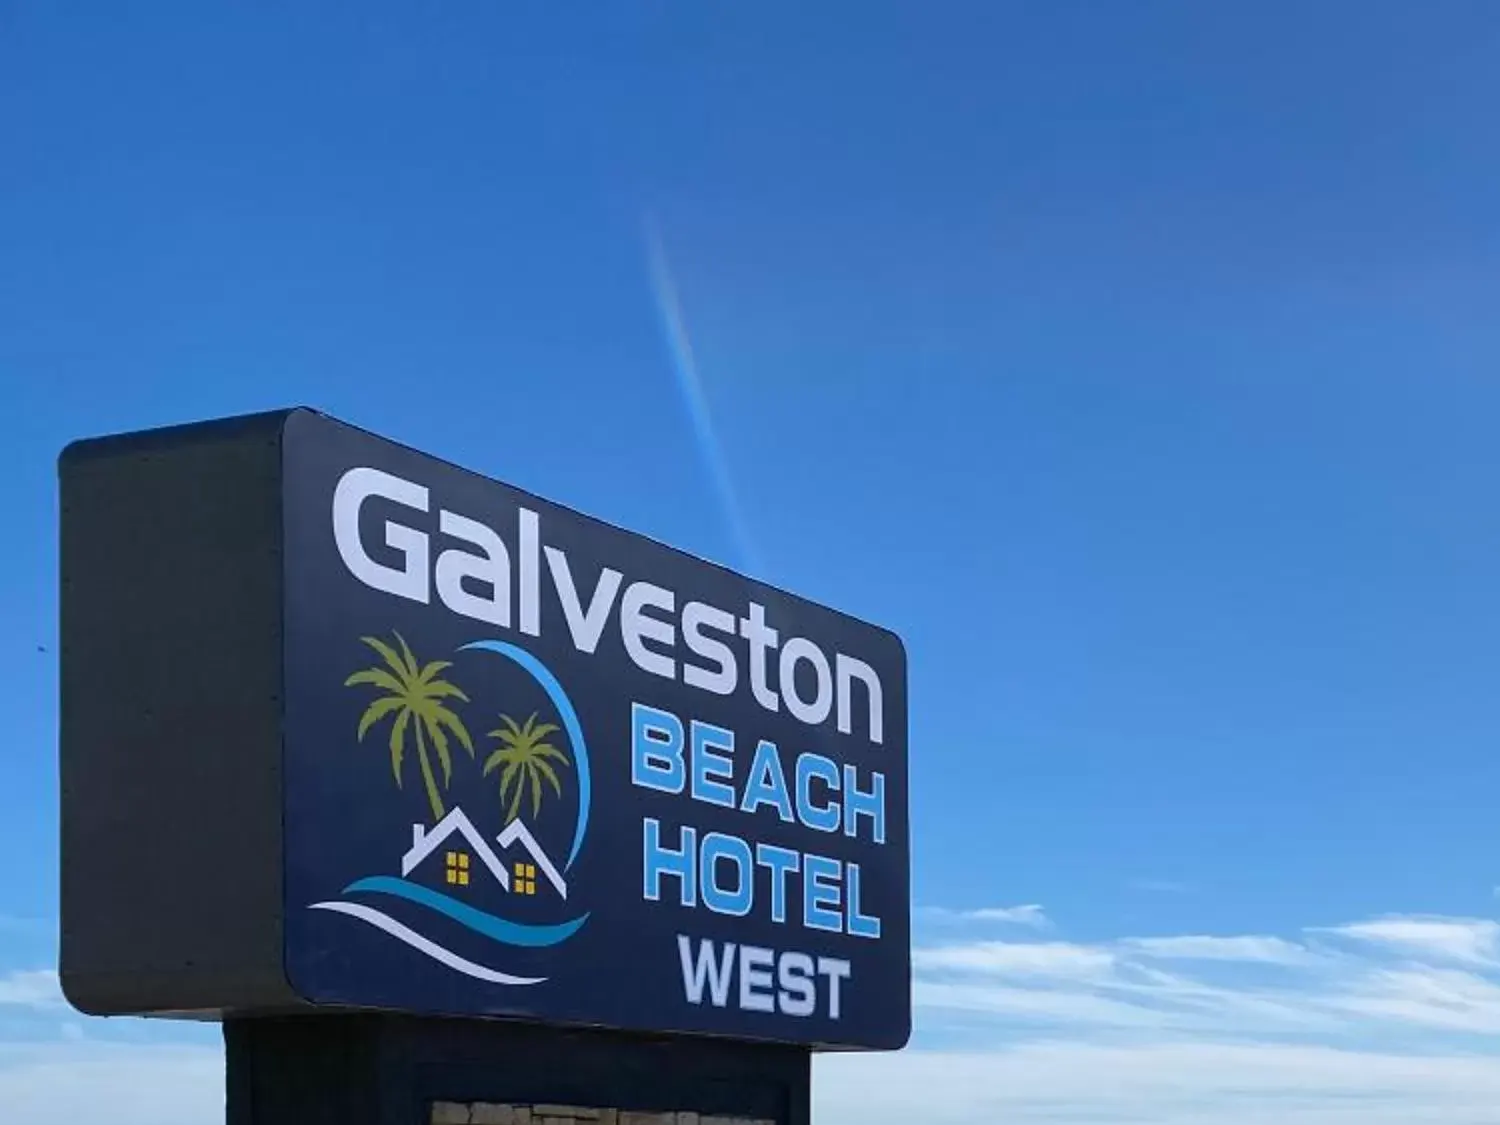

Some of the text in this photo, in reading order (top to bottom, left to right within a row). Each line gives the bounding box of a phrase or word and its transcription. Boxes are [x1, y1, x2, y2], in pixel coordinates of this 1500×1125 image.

[333, 467, 883, 744] Galveston
[632, 702, 885, 844] BEACH
[643, 817, 881, 938] HOTEL
[677, 934, 850, 1019] WEST
